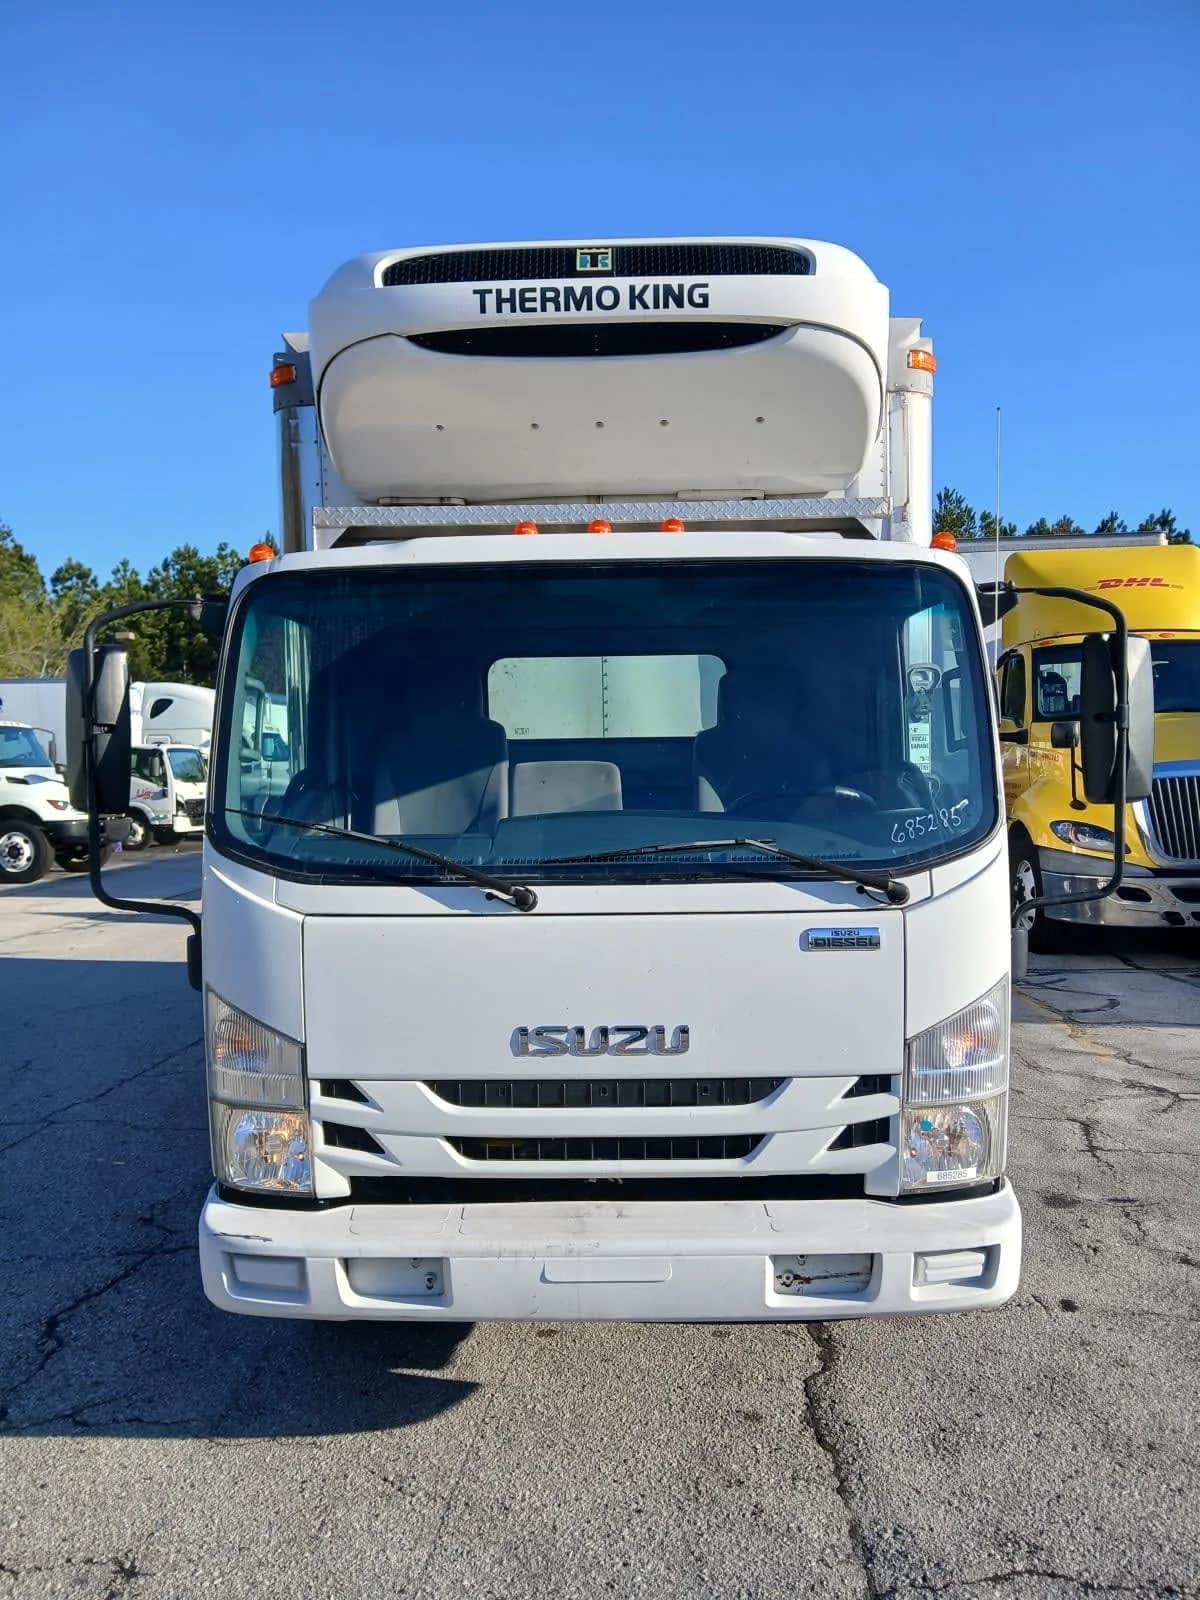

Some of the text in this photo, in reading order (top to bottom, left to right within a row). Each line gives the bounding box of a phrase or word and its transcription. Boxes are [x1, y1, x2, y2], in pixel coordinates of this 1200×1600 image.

[472, 282, 709, 314] THERMO KING
[1097, 577, 1170, 589] DHL
[891, 799, 969, 843] 685285
[812, 937, 880, 948] DIESEL
[831, 928, 860, 937] ISUZU
[510, 1024, 690, 1058] ISUZU
